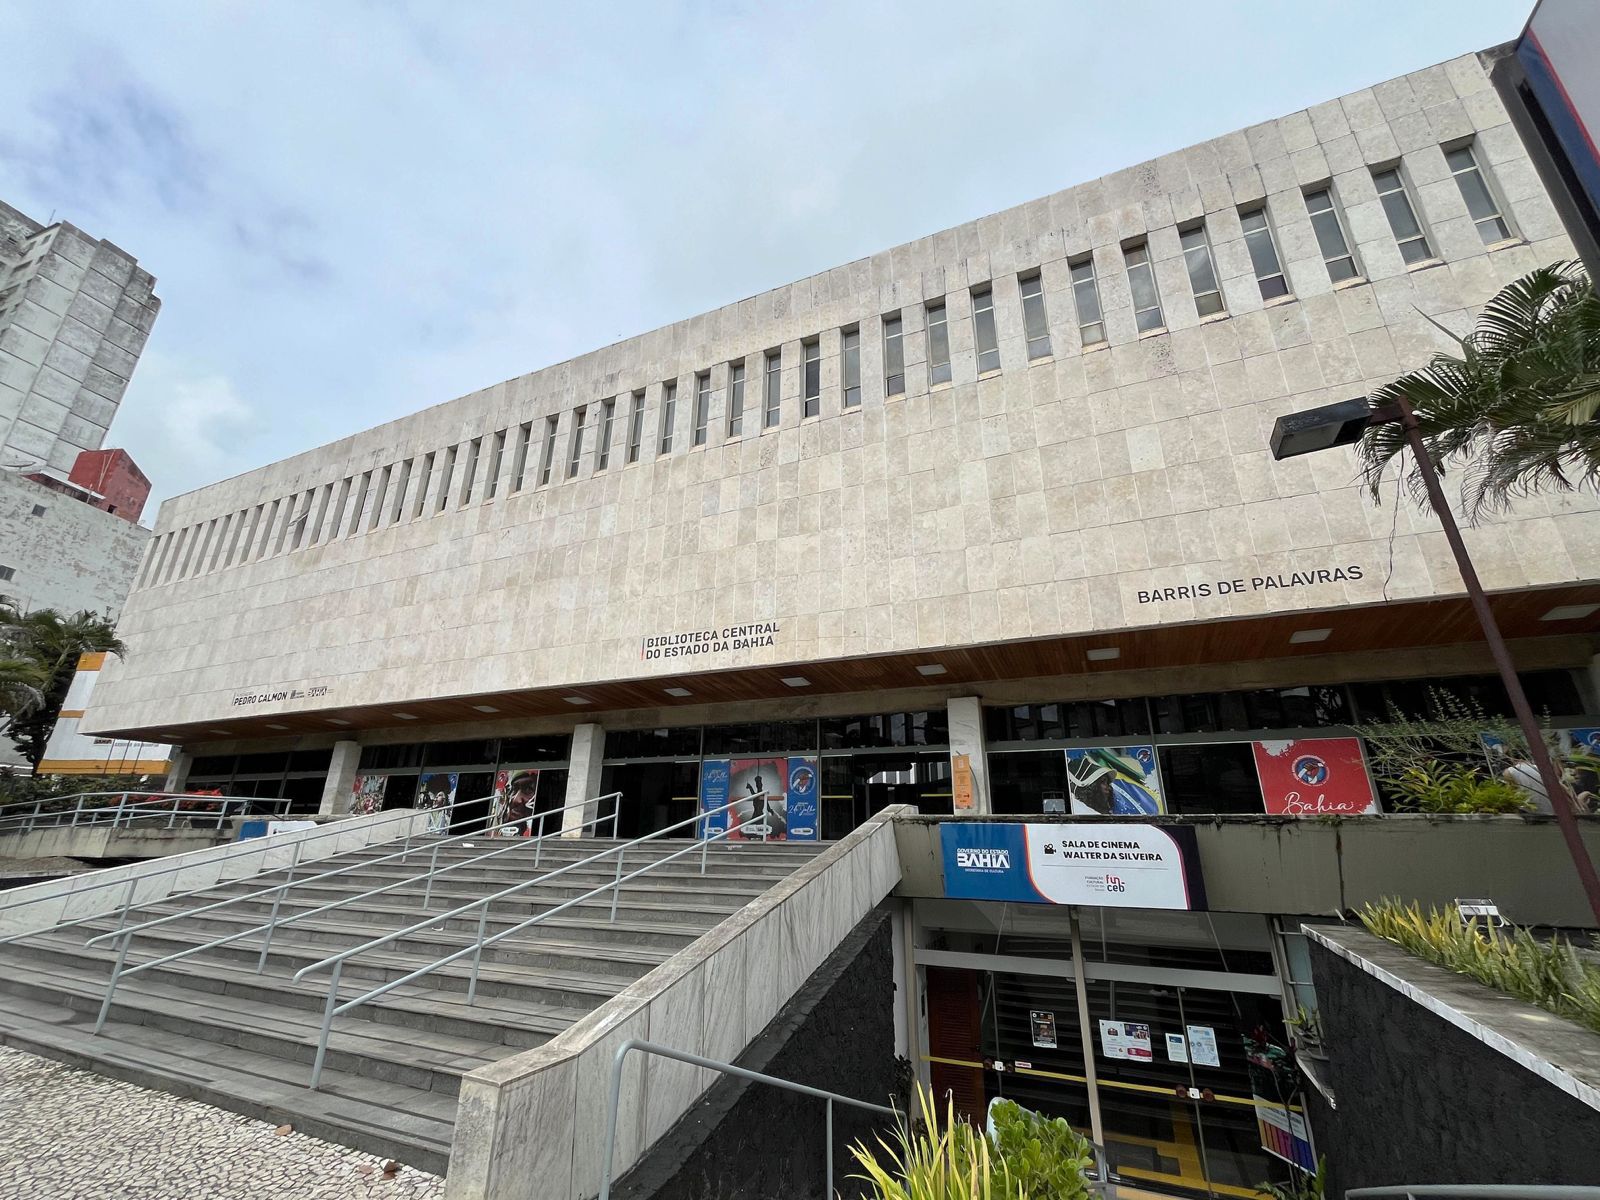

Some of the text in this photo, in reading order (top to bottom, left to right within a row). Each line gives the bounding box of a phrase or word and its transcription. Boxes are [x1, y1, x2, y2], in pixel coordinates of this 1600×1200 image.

[1137, 565, 1364, 604] BARRIS DE PALAVRAS
[647, 622, 780, 648] BIBLIOTECA CENTRAL
[646, 635, 774, 660] DO ESTADO DA BAHIA
[233, 696, 257, 706] PEDRO
[257, 691, 288, 703] CALMON
[1281, 791, 1354, 814] Bahia
[1061, 840, 1140, 849] SALA DE CINEMA
[1063, 851, 1163, 861] WALTER DA SILVEIRA
